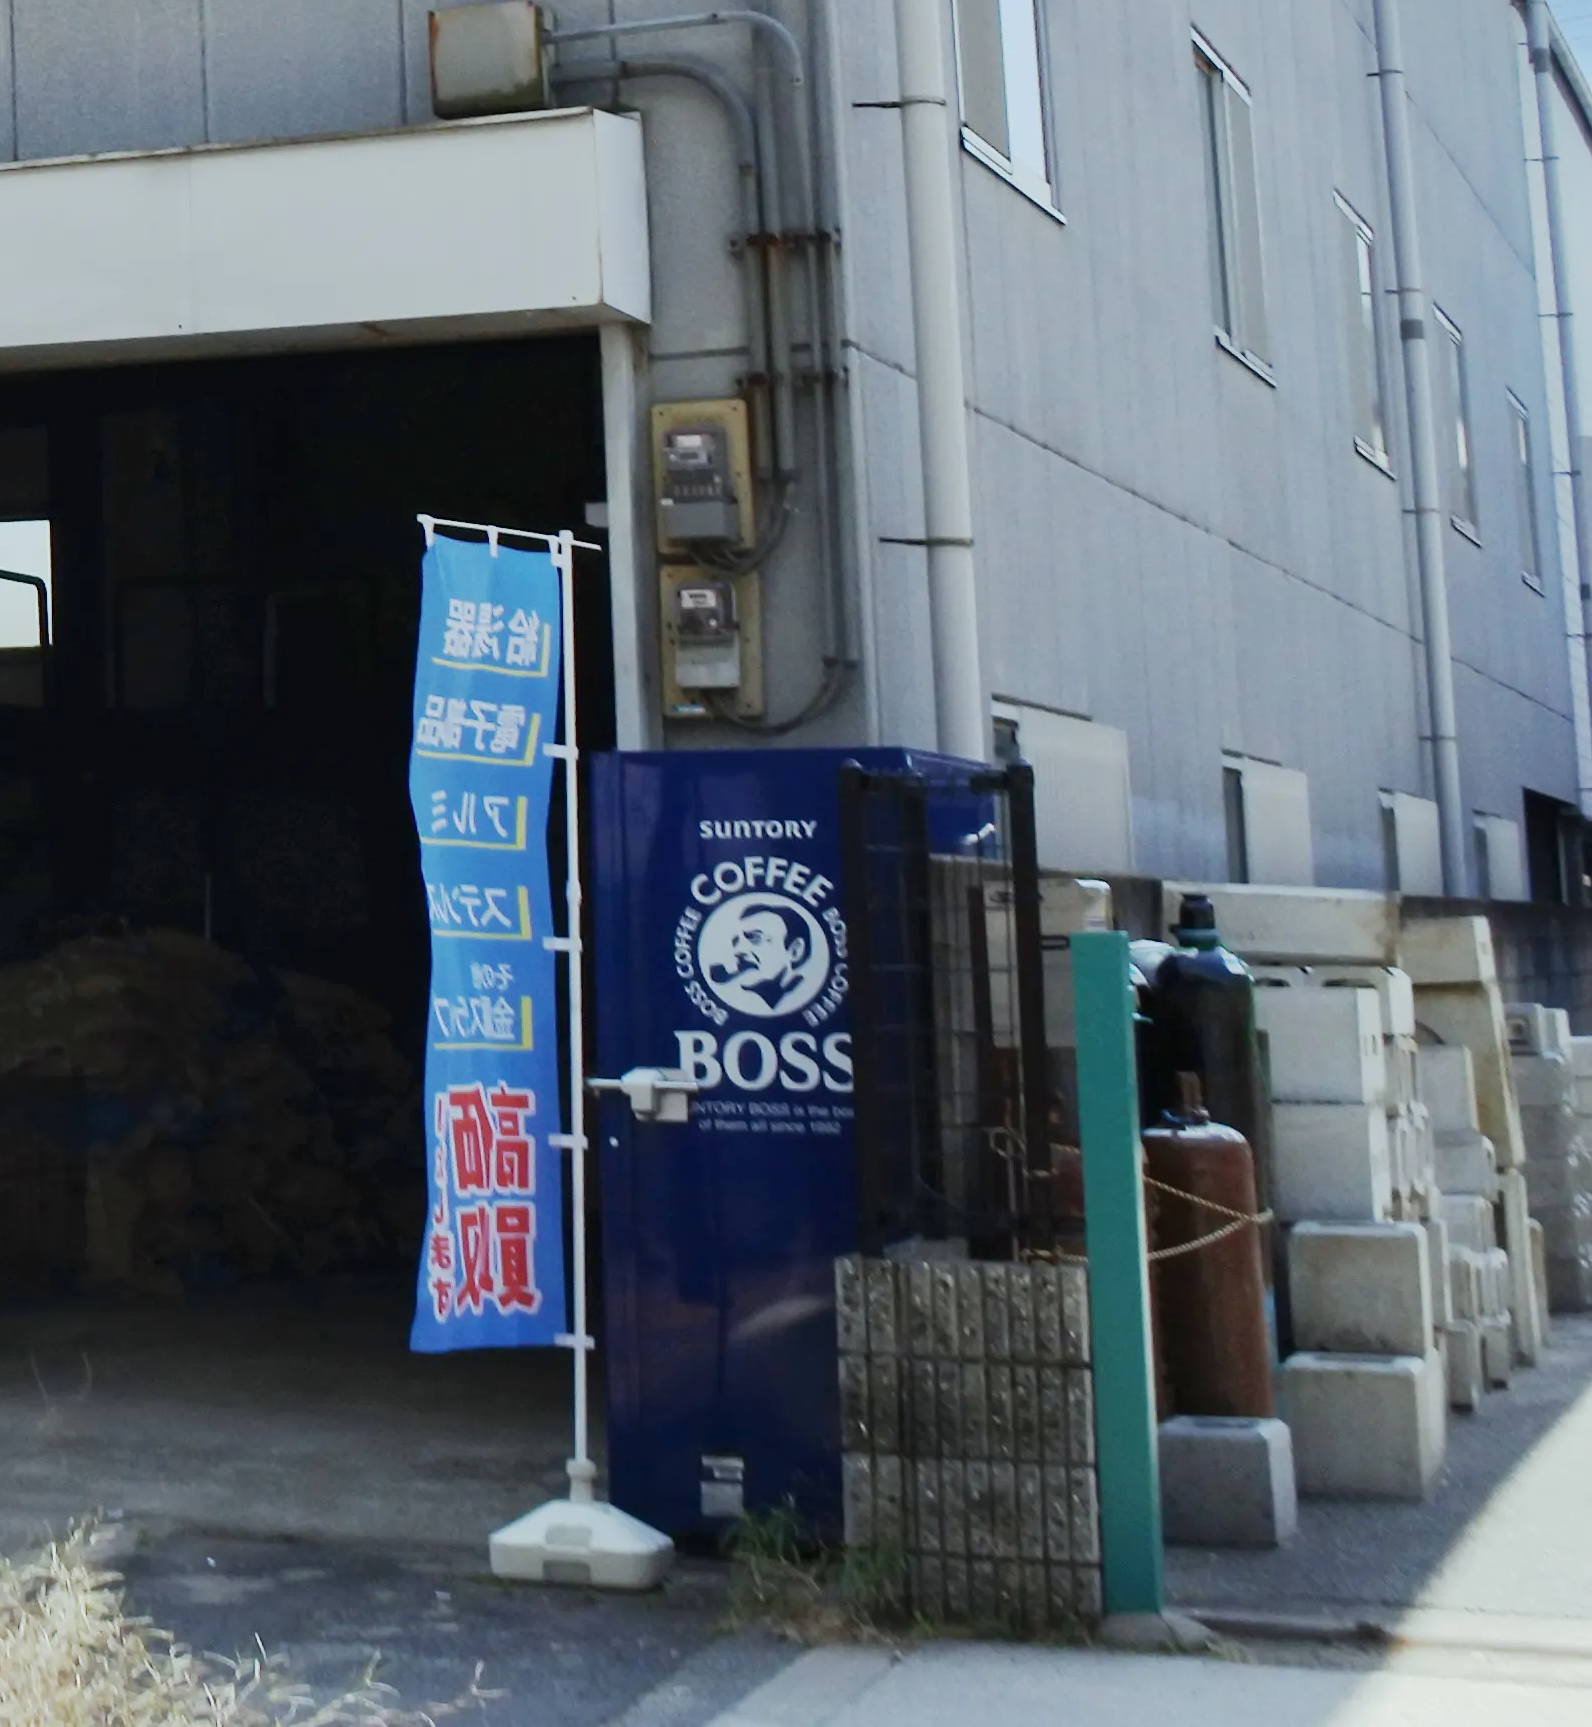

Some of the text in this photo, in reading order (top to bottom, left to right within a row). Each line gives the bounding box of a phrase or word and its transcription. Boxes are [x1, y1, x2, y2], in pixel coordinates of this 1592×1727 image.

[690, 856, 834, 908] COFFEE
[674, 906, 729, 1027] BOSS COFFEE
[802, 962, 850, 1028] COFFEE
[673, 1030, 854, 1093] BOSS
